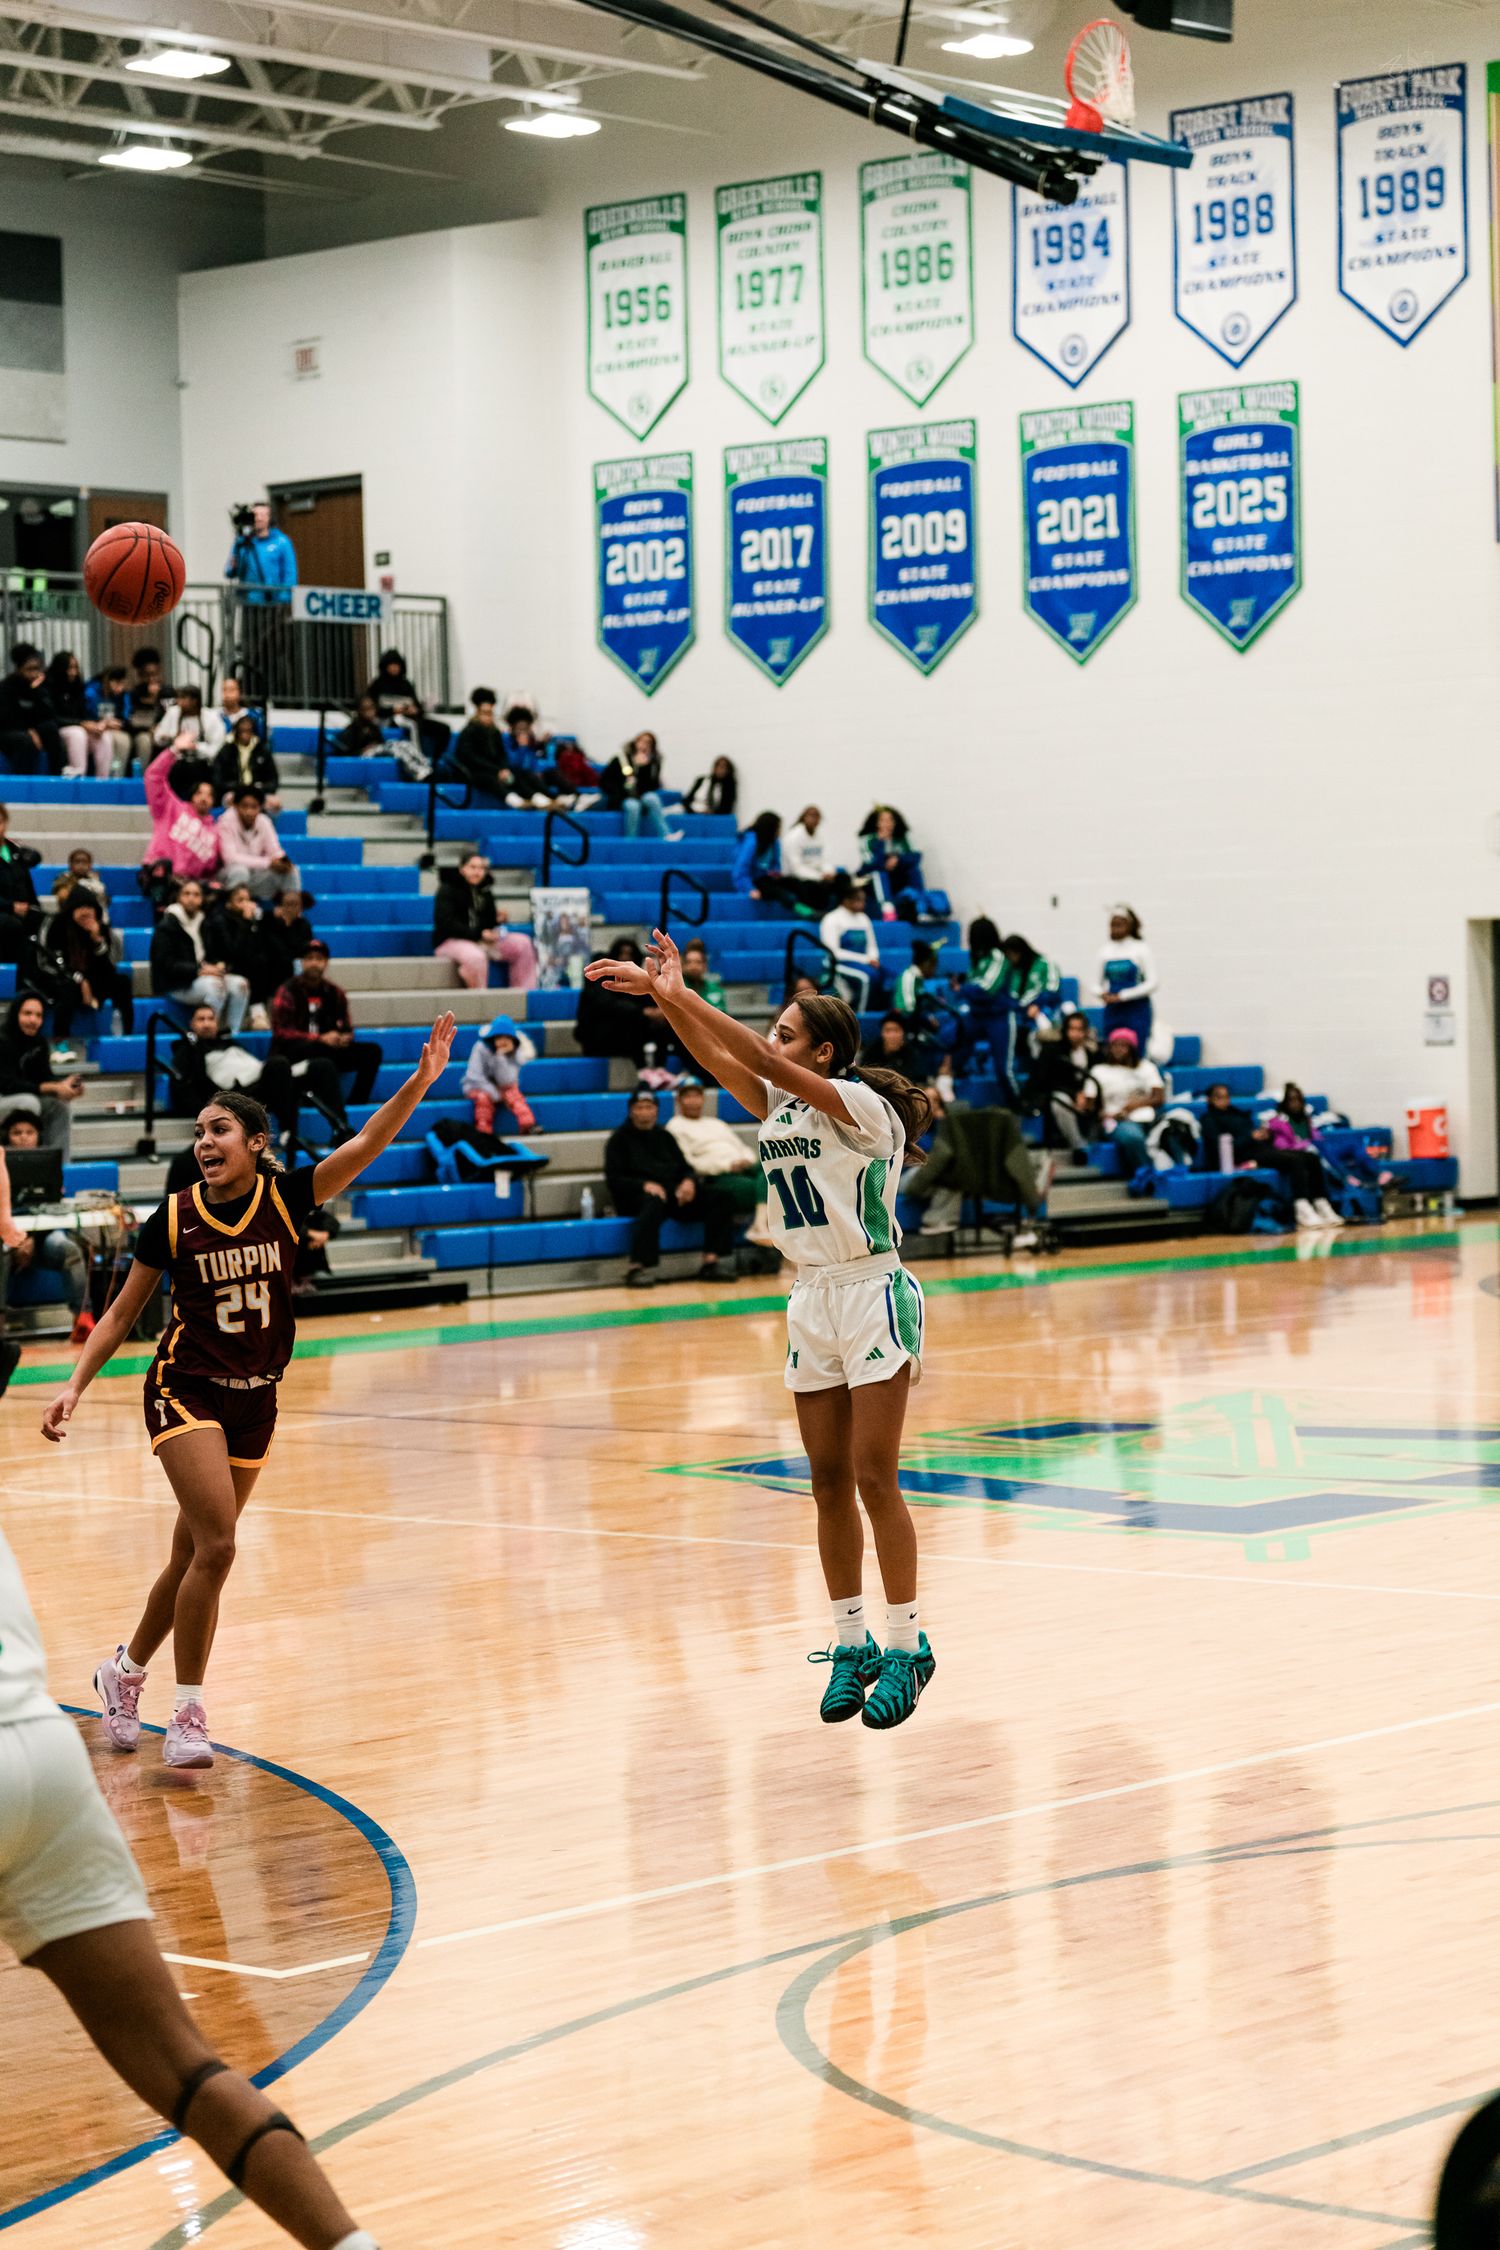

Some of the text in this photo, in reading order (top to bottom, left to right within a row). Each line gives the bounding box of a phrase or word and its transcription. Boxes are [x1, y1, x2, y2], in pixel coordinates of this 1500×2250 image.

[1377, 121, 1424, 140] BOYS
[1210, 151, 1253, 168] BOYS
[1374, 144, 1428, 163] TRACK
[1207, 171, 1258, 189] TRACK
[1359, 165, 1445, 219] 1989
[1194, 193, 1274, 244] 1988
[1032, 217, 1110, 267] 1984
[1375, 227, 1431, 244] STATE
[881, 242, 953, 289] 1986
[1209, 251, 1261, 269] STATE
[1348, 246, 1457, 272] CHAMPIONS
[736, 263, 804, 311] 1977
[1183, 270, 1286, 295] CHAMPIONS
[604, 283, 671, 329] 1956
[1022, 293, 1120, 316] CHAMPIONS
[1213, 431, 1263, 453] GIRLS
[1032, 459, 1119, 484] FOOTBALL
[1185, 451, 1291, 477] BASKETBALL
[880, 476, 962, 499] FOOTBALL
[735, 492, 814, 514] FOOTBALL
[1193, 475, 1287, 529] 2025
[1037, 493, 1120, 545] 2021
[881, 508, 967, 560] 2009
[1212, 533, 1267, 554] STATE
[741, 524, 814, 573] 2017
[1052, 550, 1105, 570] STATE
[606, 537, 686, 586] 2002
[898, 564, 949, 584] STATE
[1187, 553, 1293, 578] CHAMPIONS
[1028, 568, 1130, 592] CHAMPIONS
[306, 591, 382, 618] CHEER
[875, 582, 975, 607] CHAMPIONS
[760, 1136, 822, 1162] ARRIORS
[767, 1165, 830, 1230] 10
[195, 1240, 282, 1284] TURPIN
[214, 1280, 271, 1334] 24
